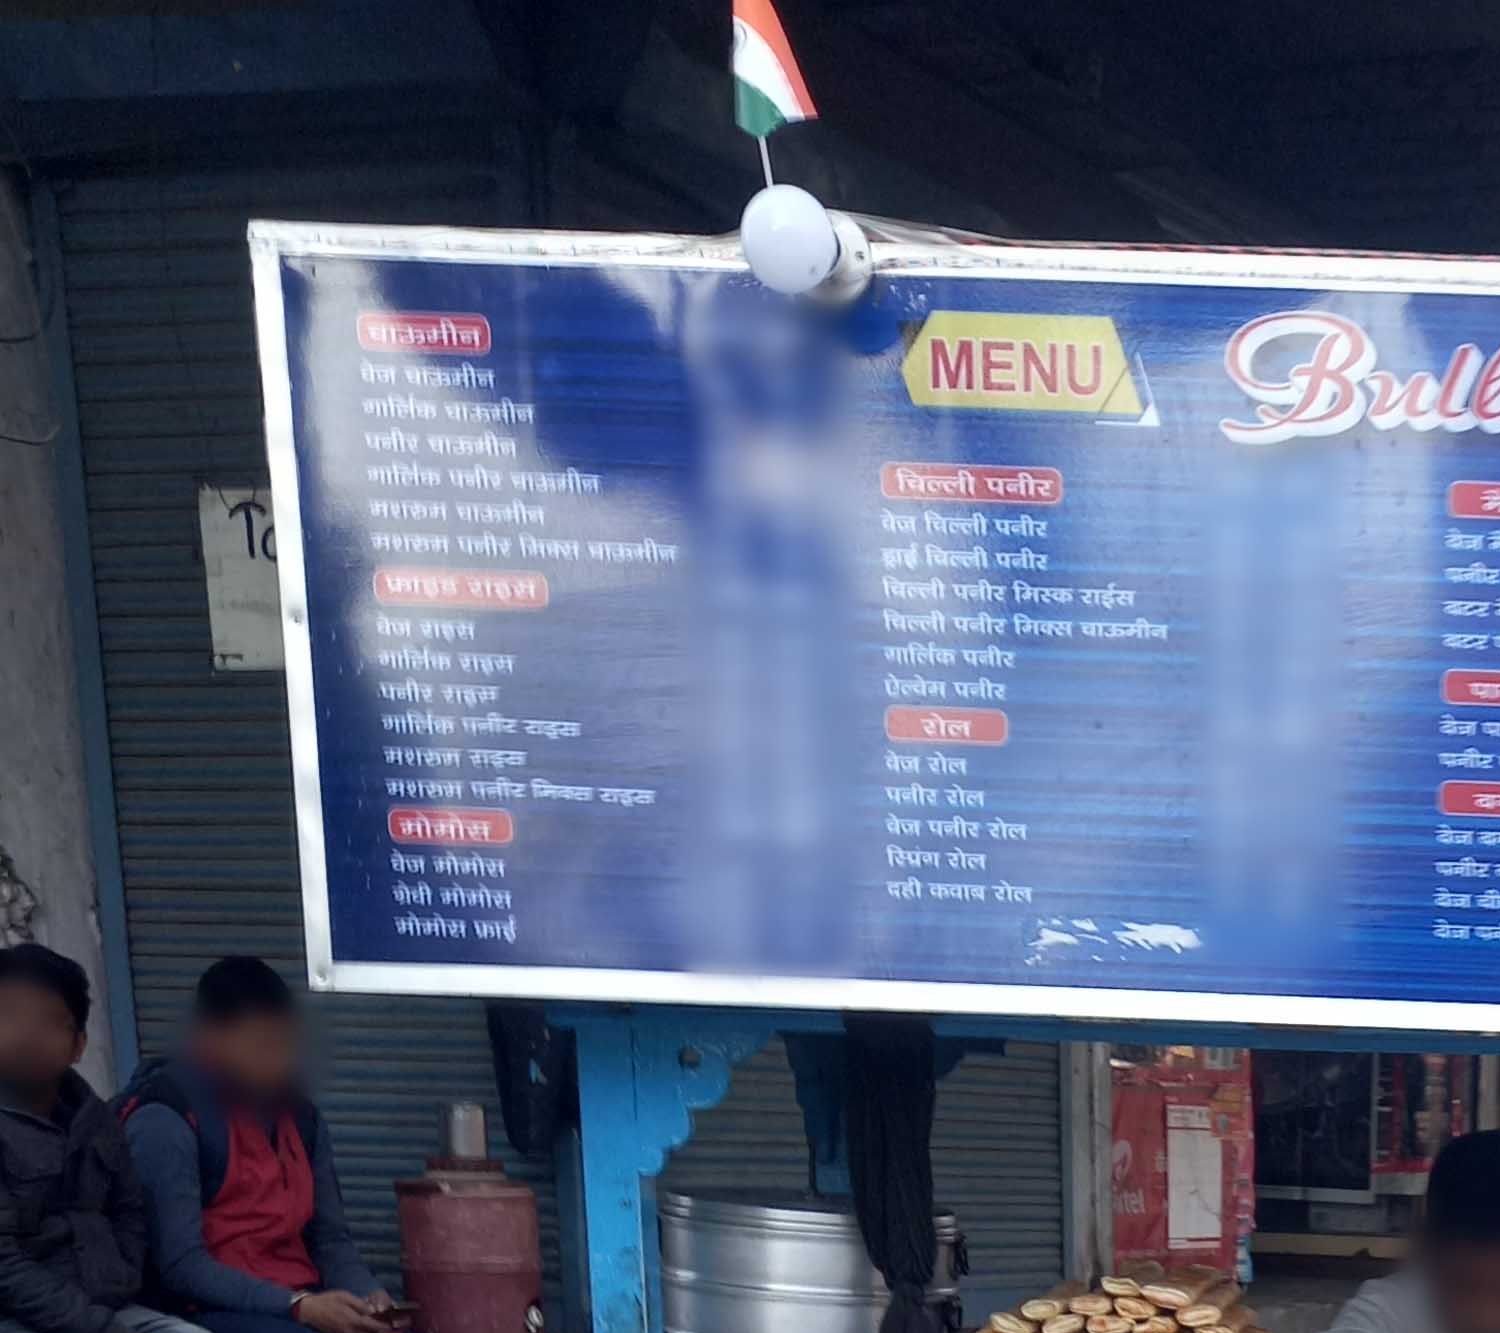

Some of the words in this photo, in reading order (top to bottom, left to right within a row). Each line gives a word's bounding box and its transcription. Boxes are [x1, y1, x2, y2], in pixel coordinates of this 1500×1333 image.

[930, 338, 1102, 397] MENU
[896, 469, 976, 496] चिल्ली
[984, 471, 1054, 498] पनीर
[880, 509, 916, 535] वेज
[925, 510, 987, 536] चिल्ली
[996, 512, 1048, 538] पनीर
[926, 544, 987, 569] चिल्ली
[996, 546, 1048, 571] पनीर
[882, 576, 945, 599] चिल्ली
[952, 579, 1006, 603] पनीर
[883, 608, 945, 633] चिल्ली
[952, 612, 1006, 636] पनीर
[1080, 617, 1168, 640] चाऊमीन
[963, 645, 1016, 669] पनीर
[953, 677, 1006, 701] पनीर
[921, 713, 972, 737] रोल
[885, 750, 920, 774] वेज
[927, 752, 967, 776] रोल
[885, 783, 936, 807] पनीर
[944, 784, 984, 808] रोल
[885, 813, 920, 838] वेज
[928, 815, 980, 839] पनीर
[987, 817, 1027, 841] रोल
[948, 847, 986, 871] रोल
[992, 880, 1032, 904] रोल
